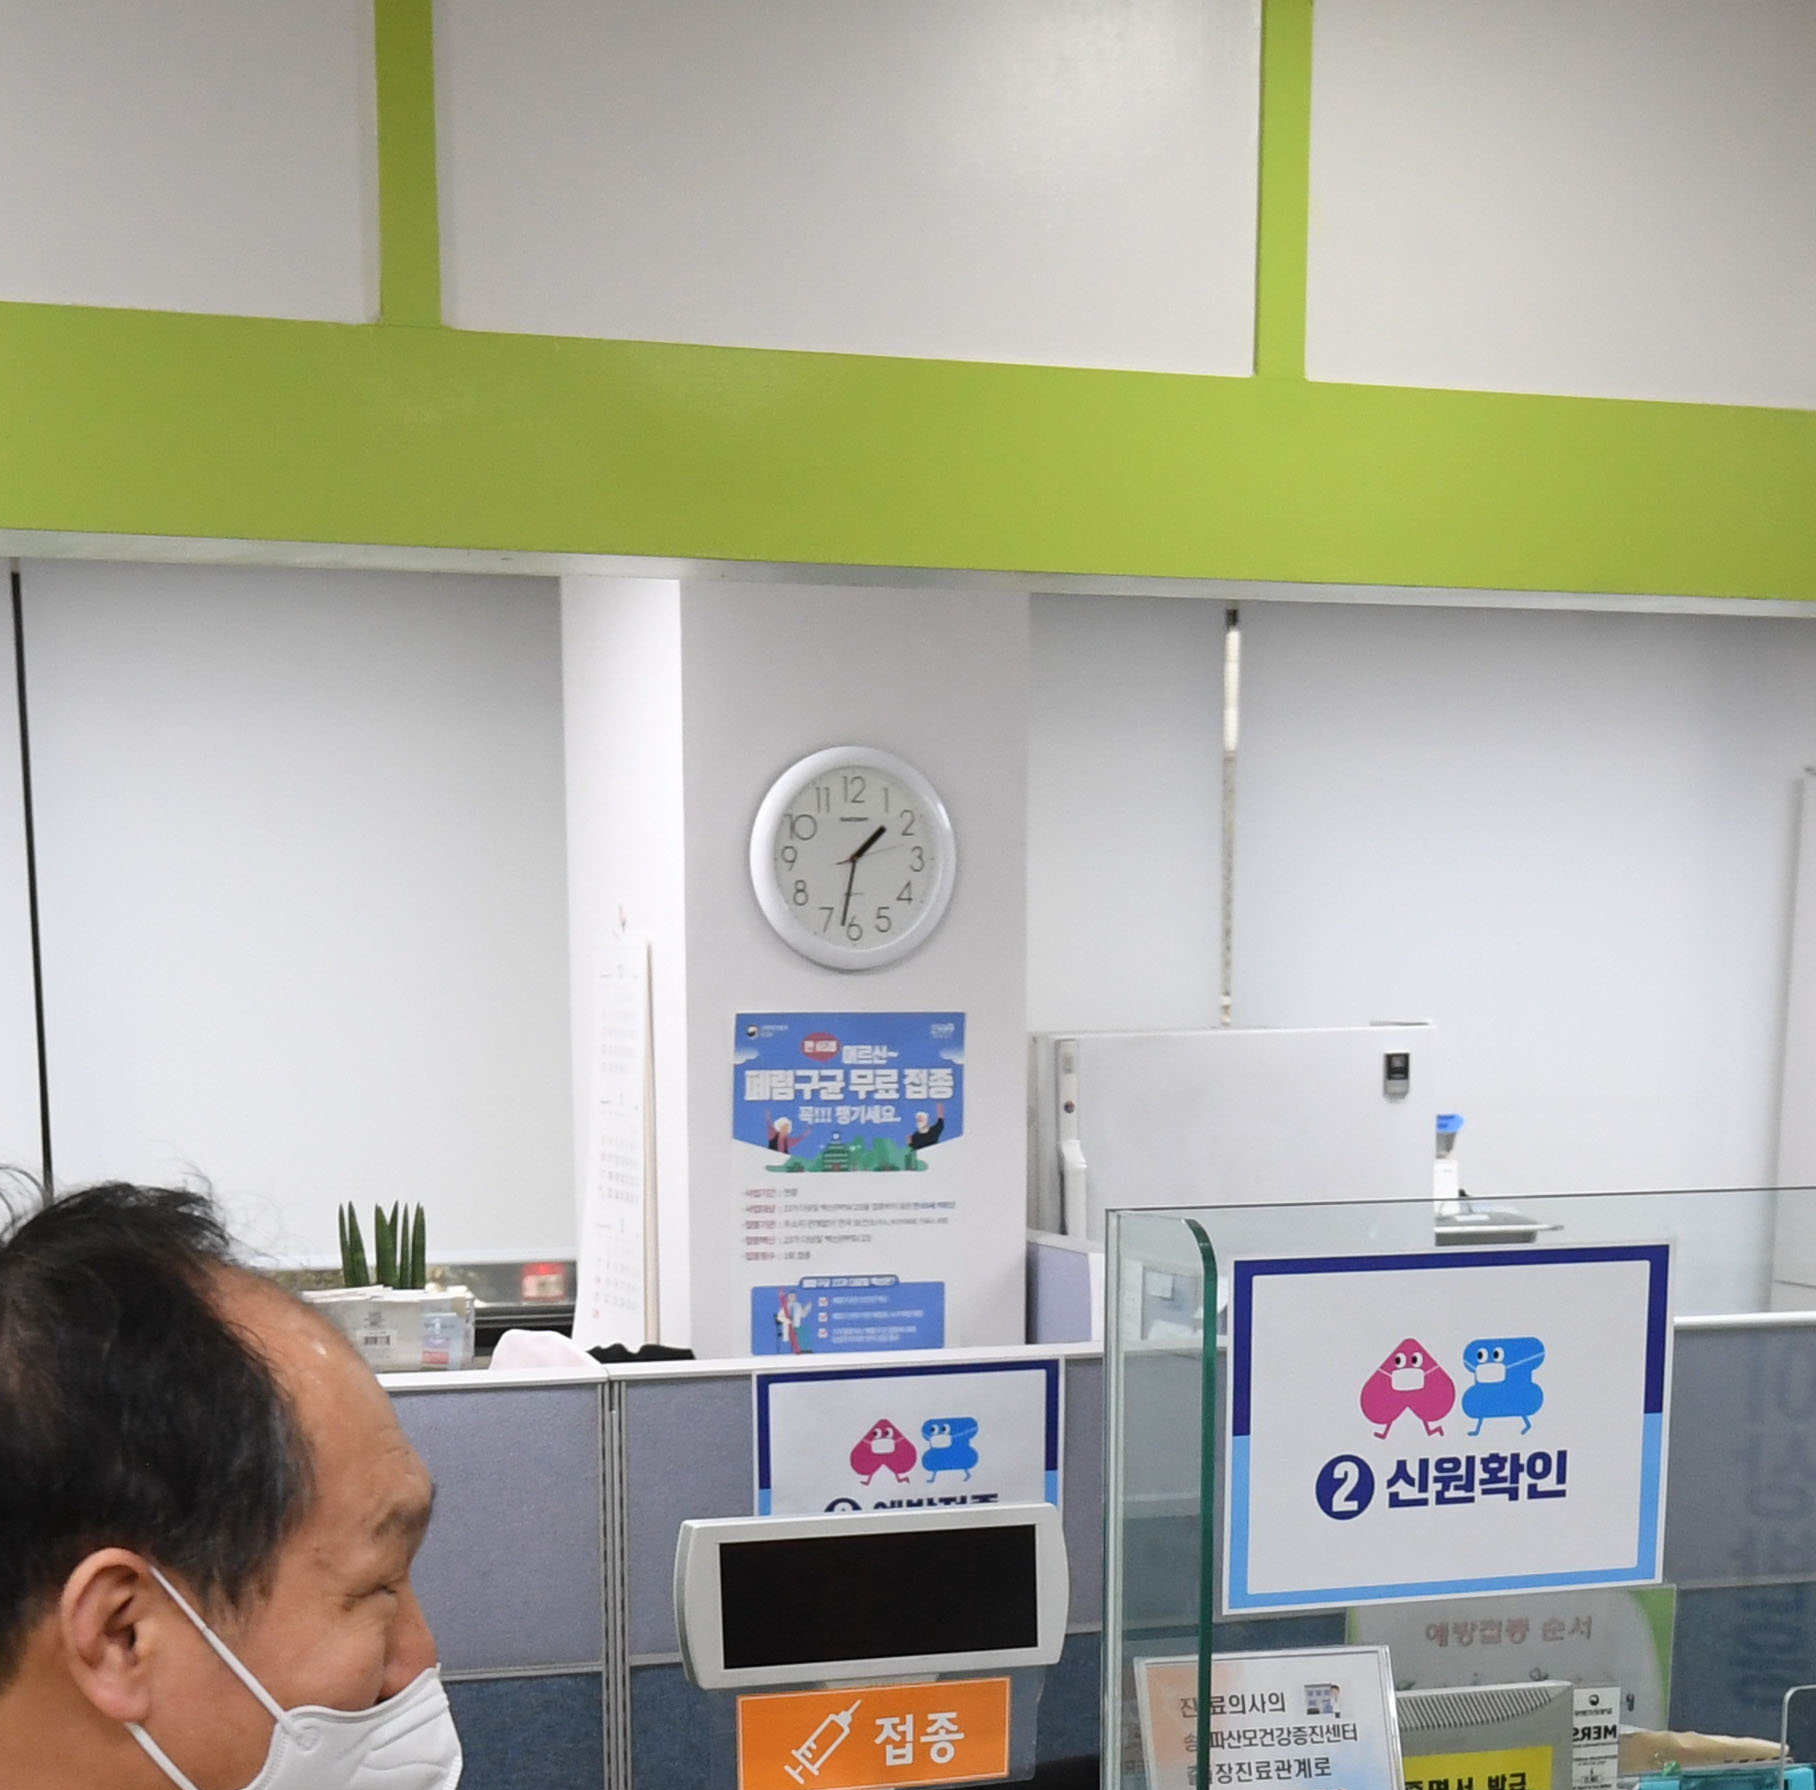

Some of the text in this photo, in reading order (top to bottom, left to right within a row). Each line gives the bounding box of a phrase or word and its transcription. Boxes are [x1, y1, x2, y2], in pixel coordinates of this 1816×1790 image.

[815, 786, 831, 814] 11
[842, 775, 866, 804] 12
[783, 813, 818, 841] 10
[899, 809, 916, 836] 2
[781, 845, 798, 871] 9
[910, 845, 926, 872] 3
[792, 879, 809, 906] 8
[895, 880, 914, 905] 4
[818, 906, 834, 932] 7
[846, 915, 864, 942] 6
[875, 906, 892, 933] 5
[744, 1067, 955, 1101] 폐렴구균 무료 접종
[1385, 1449, 1569, 1509] 신원확인
[874, 1711, 965, 1767] 접종
